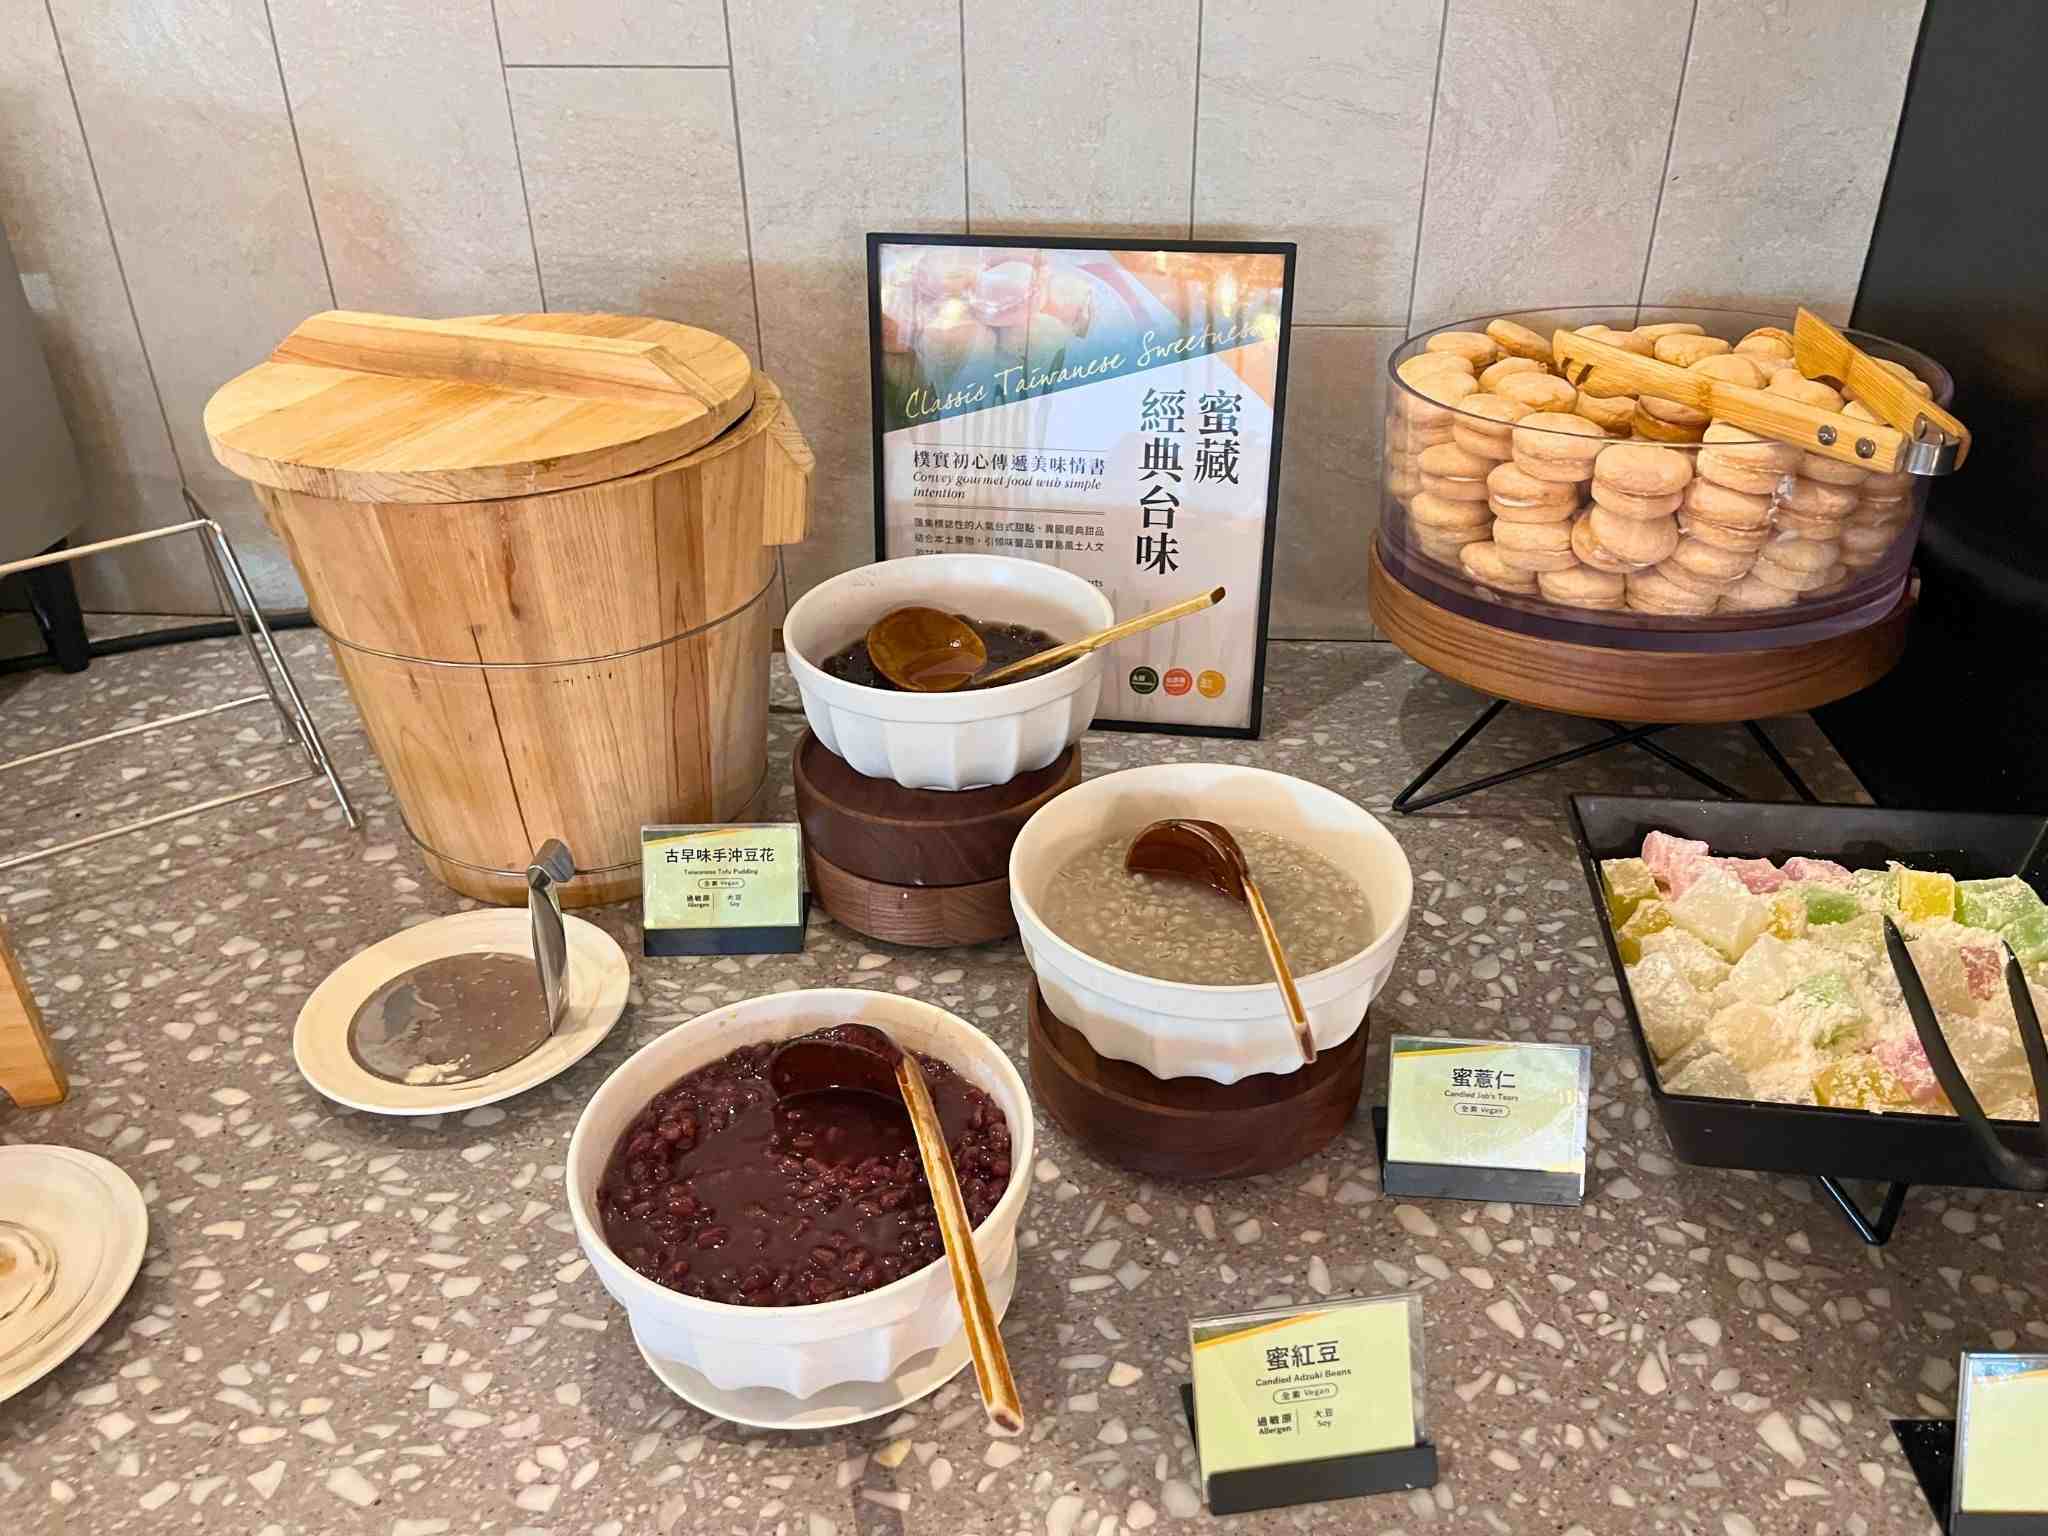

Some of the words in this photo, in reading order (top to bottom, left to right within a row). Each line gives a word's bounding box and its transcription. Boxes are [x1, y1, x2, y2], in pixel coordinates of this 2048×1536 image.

[904, 382, 986, 419] Classic
[993, 353, 1126, 397] Taiwanese
[1194, 389, 1242, 485] 蜜藏
[913, 450, 1105, 475] 樸實初心傳遞美味情書
[913, 471, 952, 486] Convey
[955, 474, 1004, 487] gourmet
[1004, 475, 1032, 489] food
[1035, 477, 1061, 488] with
[1064, 478, 1102, 492] simple
[1136, 387, 1186, 575] 經典台味
[913, 488, 966, 499] intention
[665, 847, 775, 864] 古早味手沖豆花
[1452, 1067, 1516, 1090] 蜜薏仁
[1444, 1089, 1476, 1098] Candied
[1266, 1340, 1340, 1372] 蜜紅豆
[1255, 1375, 1292, 1387] Candied
[1294, 1371, 1323, 1383] Adzuki
[1325, 1368, 1352, 1378] Beans
[1303, 1387, 1330, 1397] Vegan
[1258, 1425, 1292, 1435] Allergen
[1317, 1419, 1331, 1428] Soy
